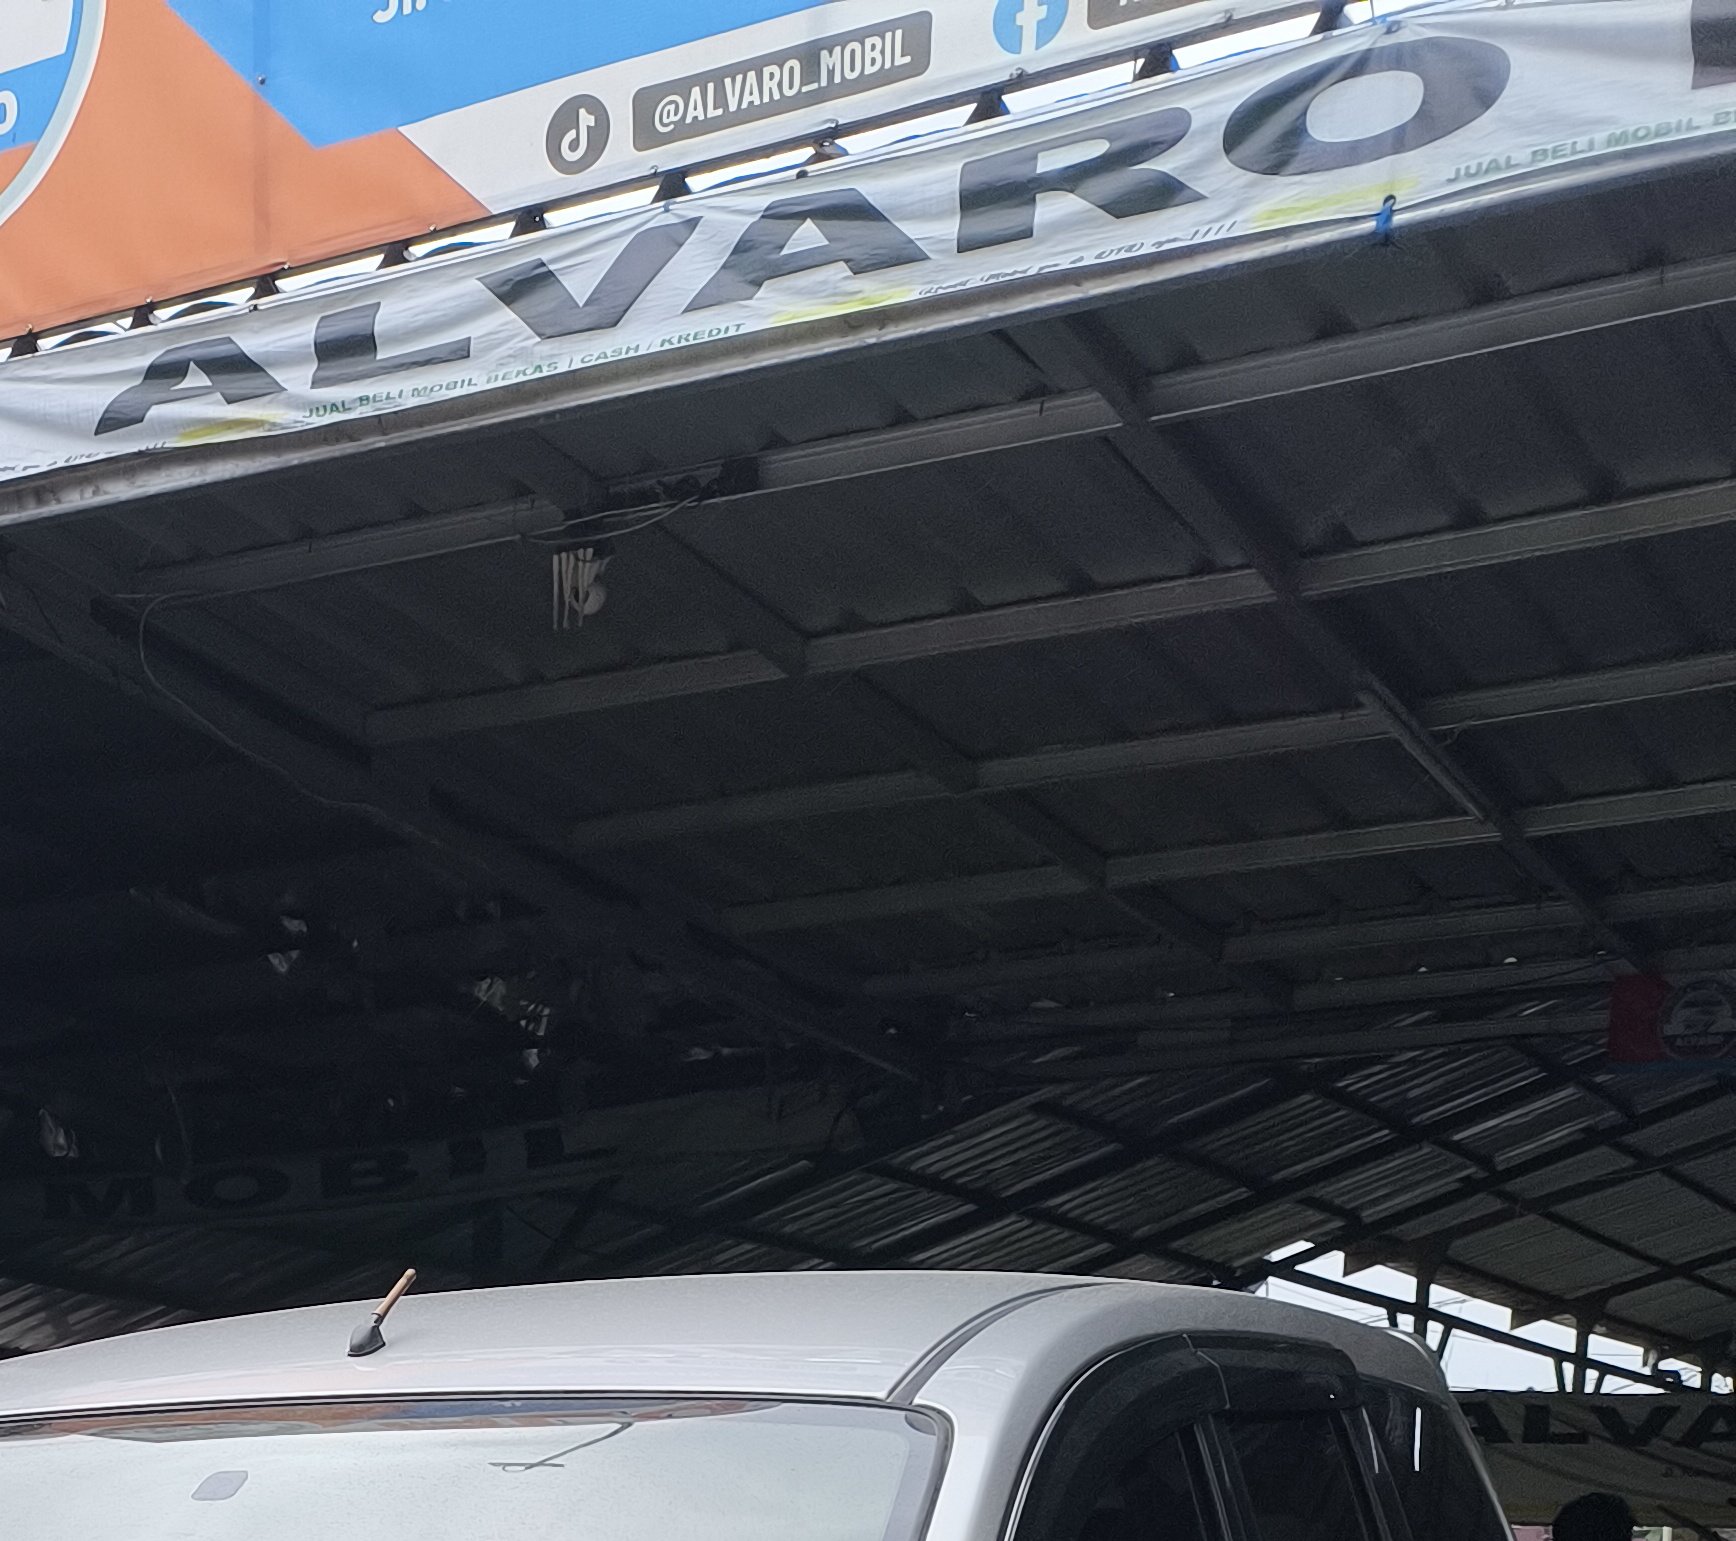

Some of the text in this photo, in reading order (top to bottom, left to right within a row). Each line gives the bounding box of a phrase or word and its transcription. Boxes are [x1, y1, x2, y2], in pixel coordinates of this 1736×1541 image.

[653, 28, 912, 134] @ALVARO_MOBIL
[1447, 154, 1521, 184] JUAL
[1529, 136, 1596, 165] BELI
[1605, 116, 1702, 148] MOBIL
[95, 36, 1512, 437] ALVARO
[302, 401, 353, 420] JUAL
[357, 389, 406, 407] BELI
[410, 377, 478, 399] MOBIL
[580, 343, 641, 365] CASH
[659, 322, 747, 349] KREDIT
